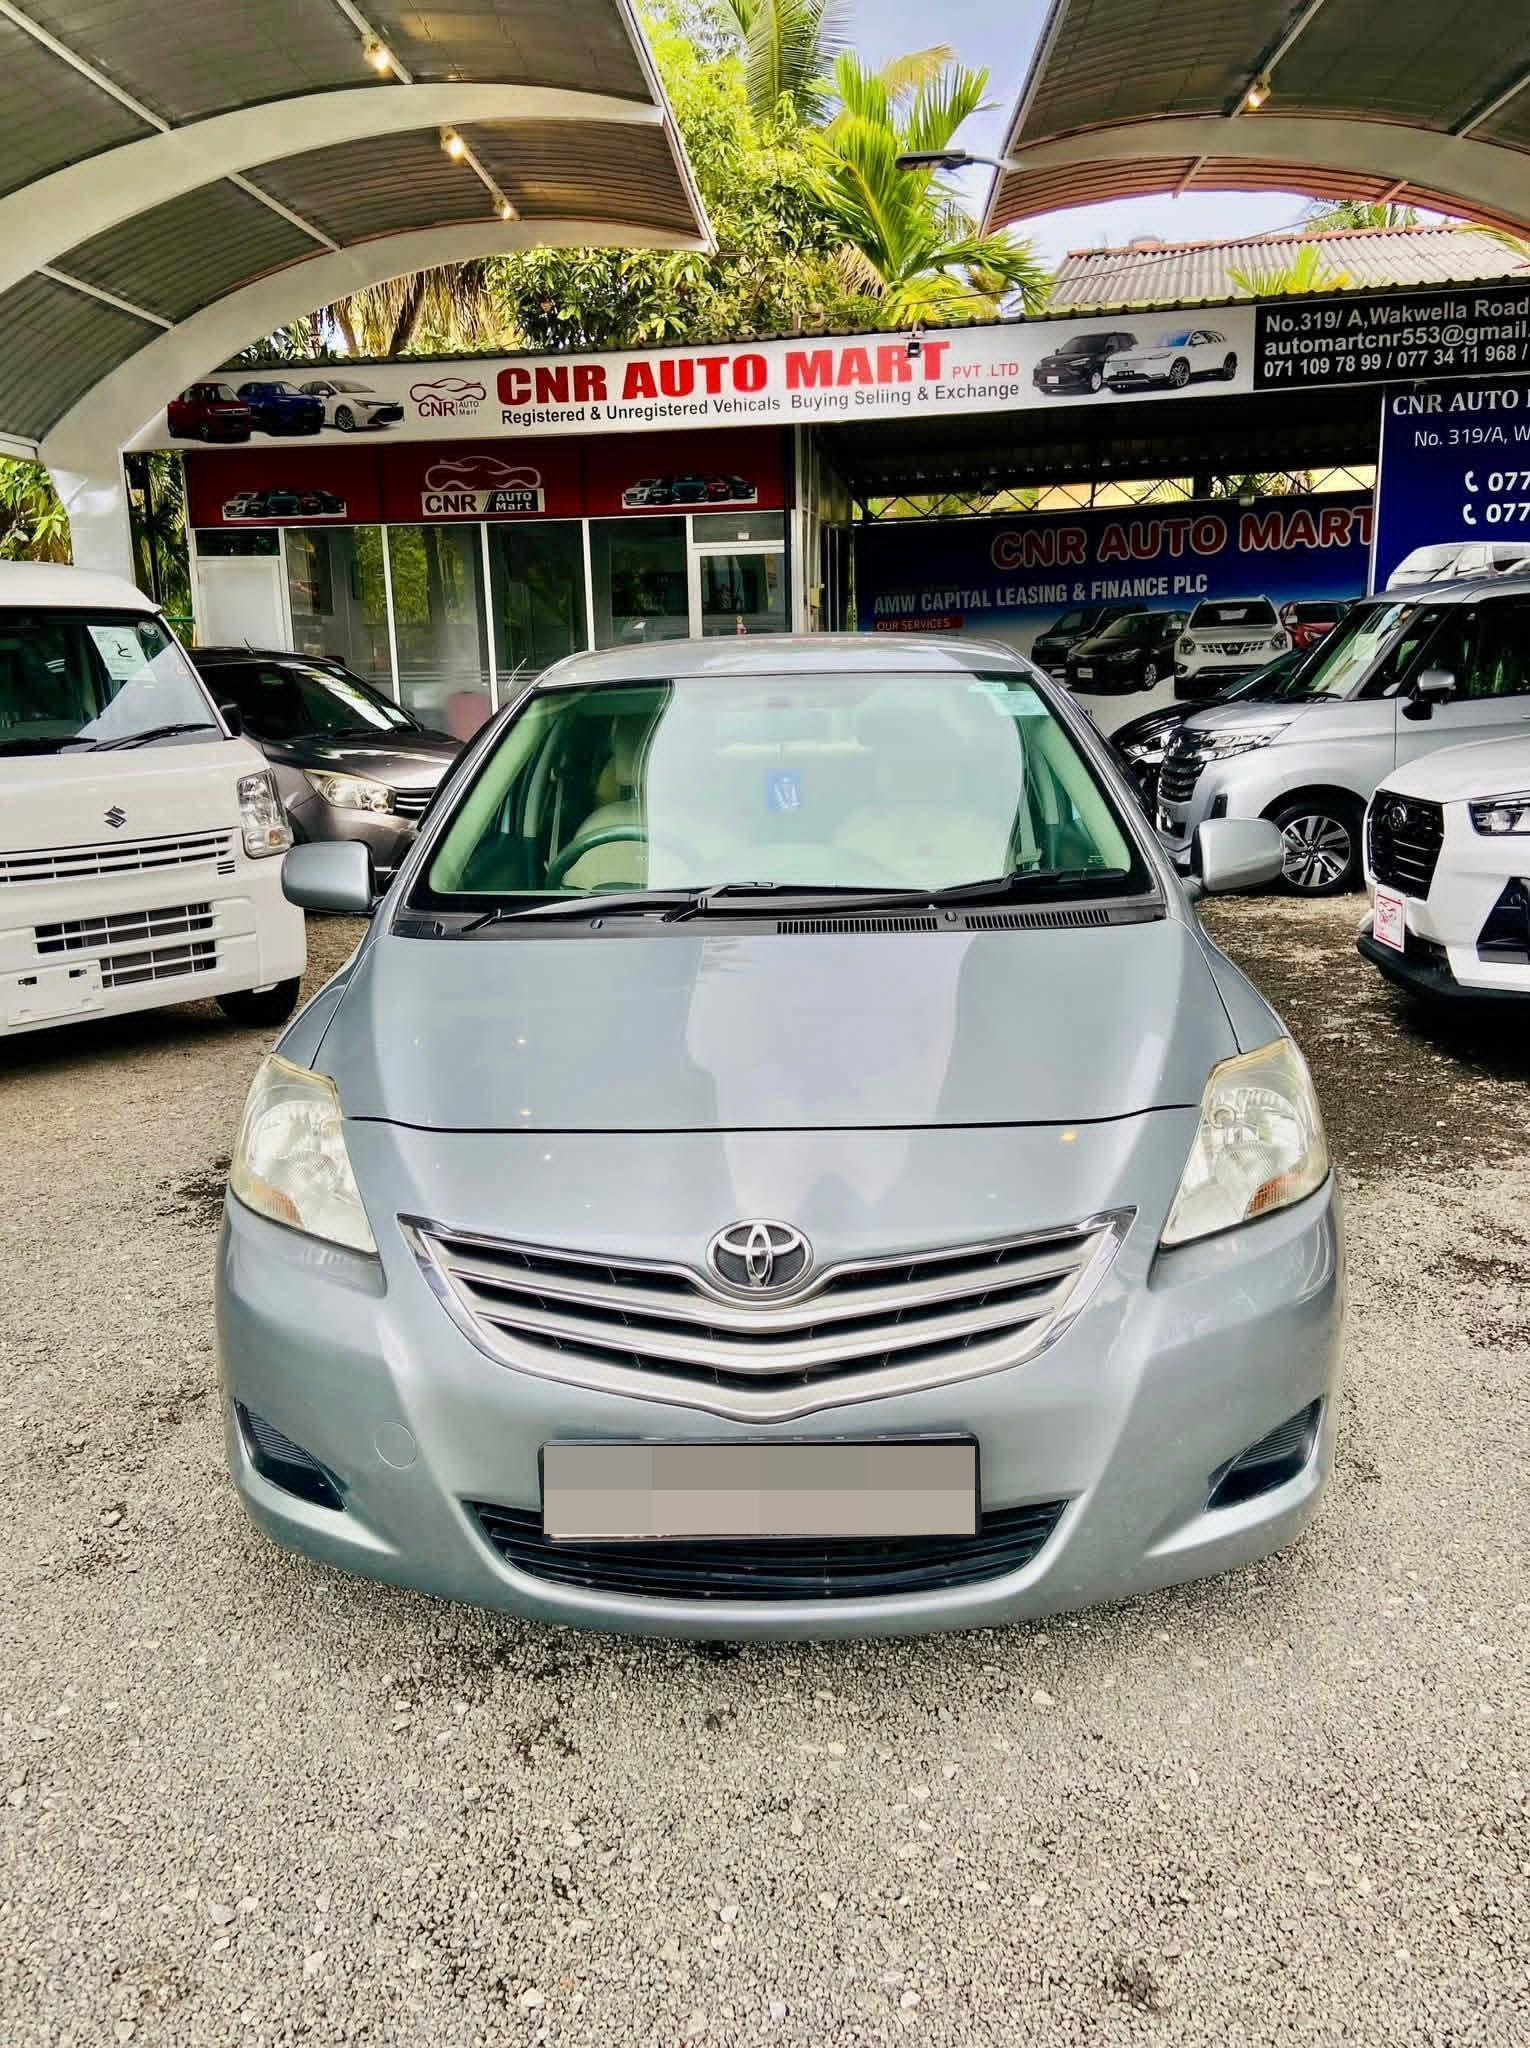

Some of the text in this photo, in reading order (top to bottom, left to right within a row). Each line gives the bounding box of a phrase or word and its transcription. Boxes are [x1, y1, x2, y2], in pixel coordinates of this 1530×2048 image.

[1474, 295, 1529, 318] Road
[1263, 360, 1293, 378] 071
[1300, 358, 1330, 375] 109
[1336, 356, 1355, 373] 78
[1360, 354, 1381, 371] 99
[1396, 350, 1427, 368] 077
[1434, 347, 1454, 365] 34
[1461, 346, 1478, 364] 11
[1485, 344, 1517, 362] 968
[496, 365, 608, 406] CNR
[622, 354, 768, 400] AUTO
[785, 341, 950, 391] MART
[952, 364, 982, 380] PVT
[418, 401, 456, 417] CNR
[501, 407, 585, 427] Registered
[590, 407, 601, 420] &
[606, 400, 708, 424] Unregistered
[713, 396, 780, 414] Vehicals
[791, 393, 849, 412] Buying
[917, 386, 929, 400] &
[935, 383, 1019, 400] Exchange
[1392, 394, 1443, 416] CNR
[1449, 389, 1519, 411] AUTO
[1414, 430, 1443, 447] No.
[1448, 426, 1508, 445] 319/A,
[424, 493, 477, 513] CNR
[495, 492, 533, 502] AUTO
[495, 502, 532, 511] Mart
[991, 506, 1374, 570] CNR AUTO MART
[874, 574, 1208, 614] AMW CAPITAL LEASING & FINANCE PLC
[876, 617, 950, 632] OUR SERVICES
